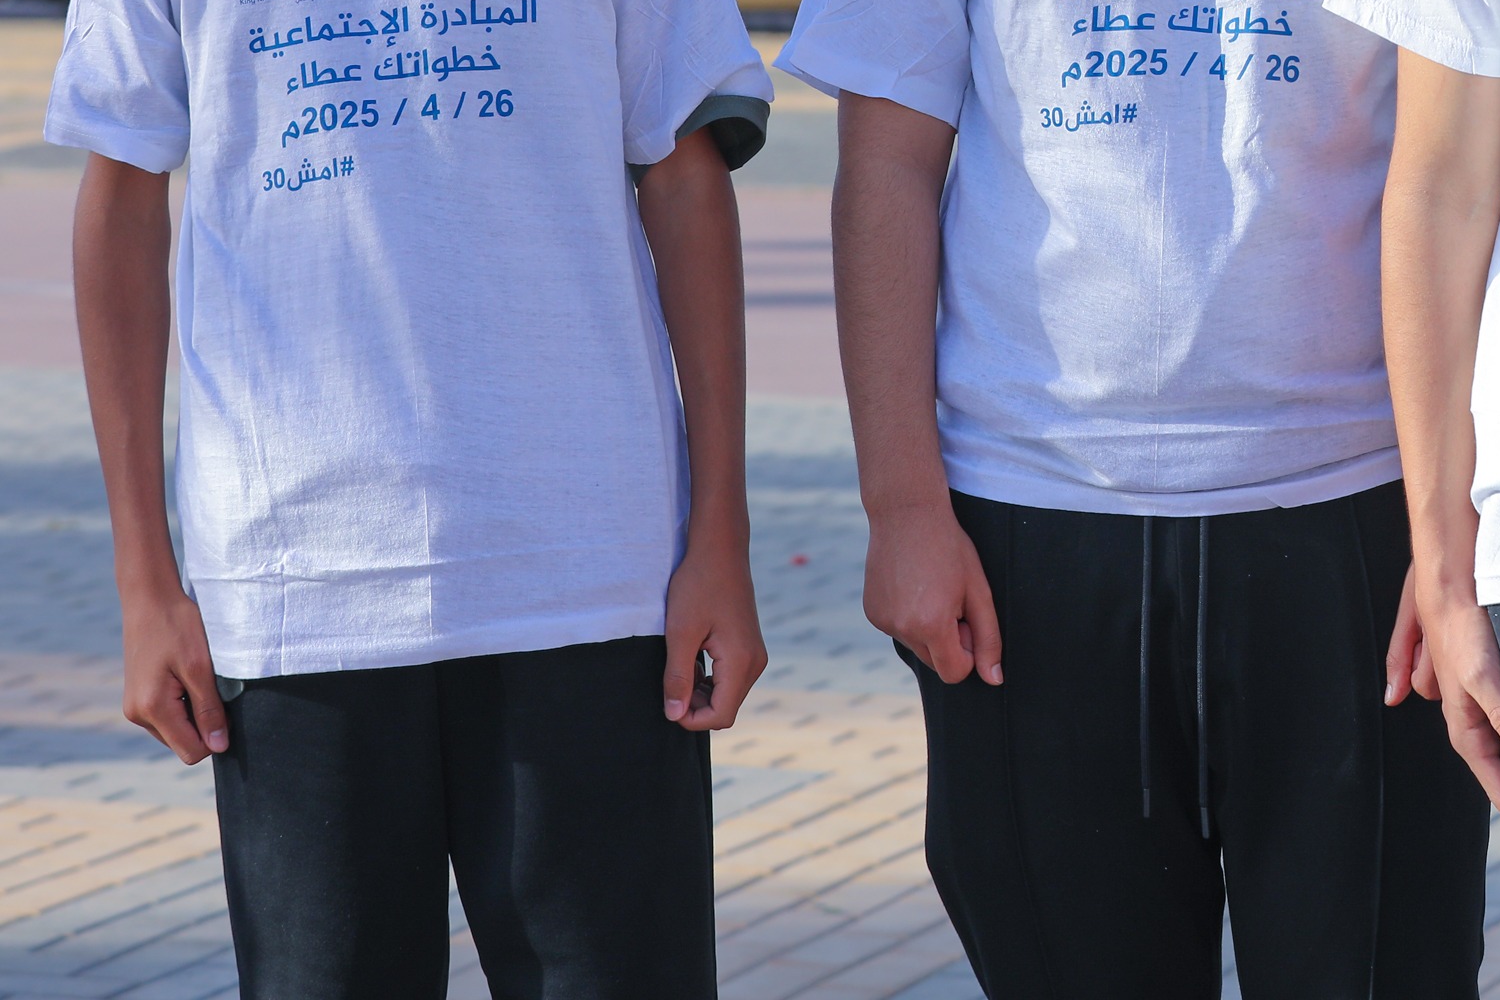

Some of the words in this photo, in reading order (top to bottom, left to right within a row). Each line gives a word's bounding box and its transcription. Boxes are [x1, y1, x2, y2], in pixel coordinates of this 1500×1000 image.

[249, 5, 409, 59] الإجتماعية
[1072, 6, 1155, 36] عطاء
[1168, 5, 1292, 43] خطواتك
[374, 44, 501, 82] خطواتك
[1181, 52, 1198, 77] /
[1209, 54, 1227, 80] 4
[1237, 55, 1254, 81] /
[1266, 55, 1300, 82] 26
[286, 60, 362, 95] عطاء
[392, 98, 408, 125] /
[421, 93, 441, 121] 4
[454, 92, 466, 119] /
[479, 90, 514, 117] 26
